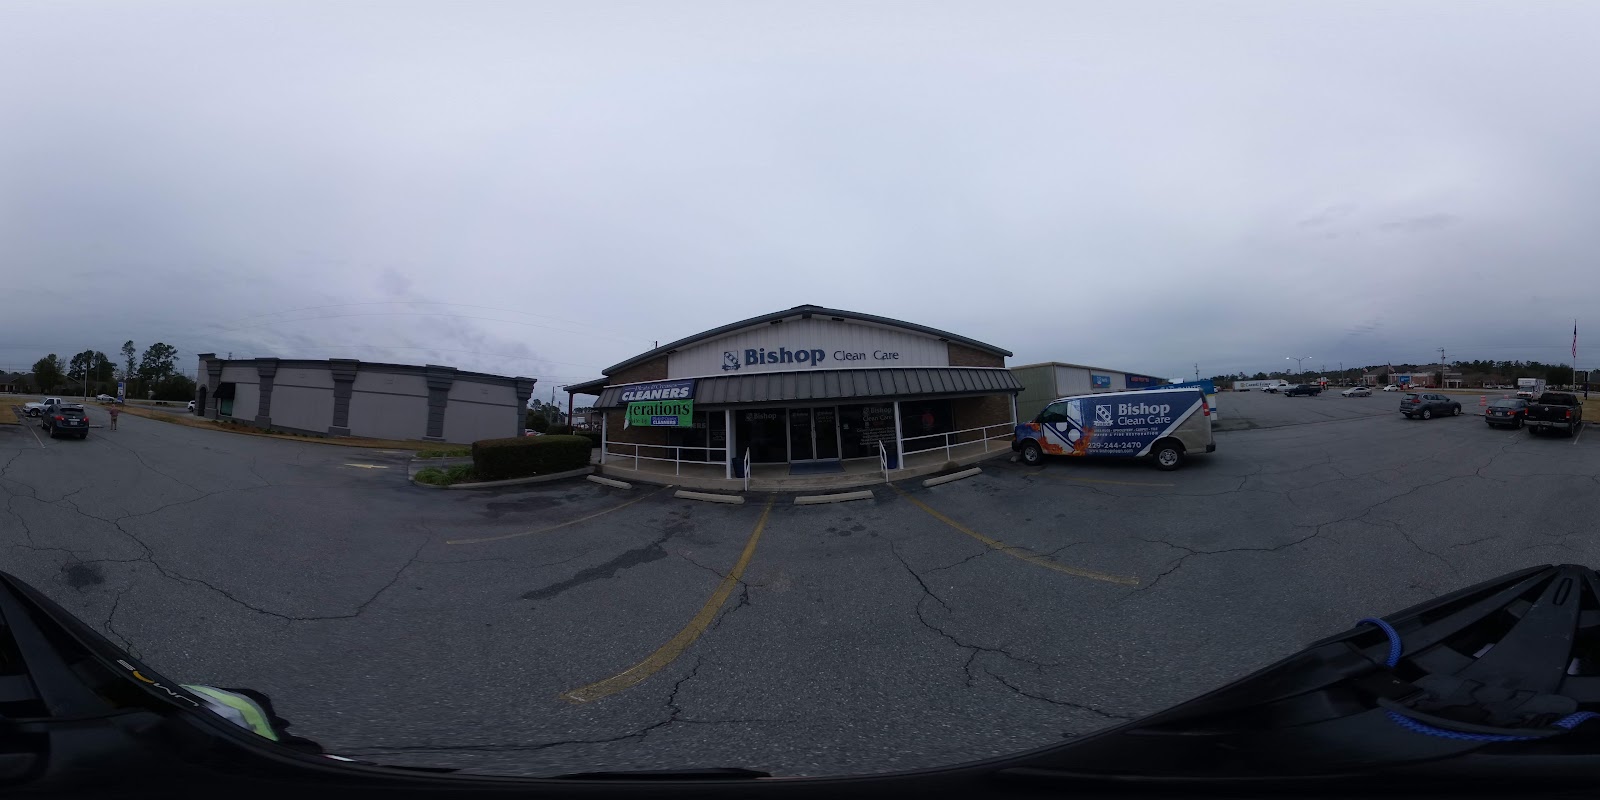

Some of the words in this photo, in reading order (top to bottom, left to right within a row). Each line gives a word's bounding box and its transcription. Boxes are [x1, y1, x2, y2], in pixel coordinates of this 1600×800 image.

[744, 347, 826, 366] Bishop
[833, 350, 866, 361] Clean
[873, 350, 899, 360] Care
[621, 386, 690, 401] CLEANERS
[753, 412, 777, 420] Bishop
[1118, 402, 1170, 417] Bishop
[1118, 416, 1145, 426] Clean
[1147, 415, 1171, 425] Care
[1087, 441, 1142, 449] 229-244-2470
